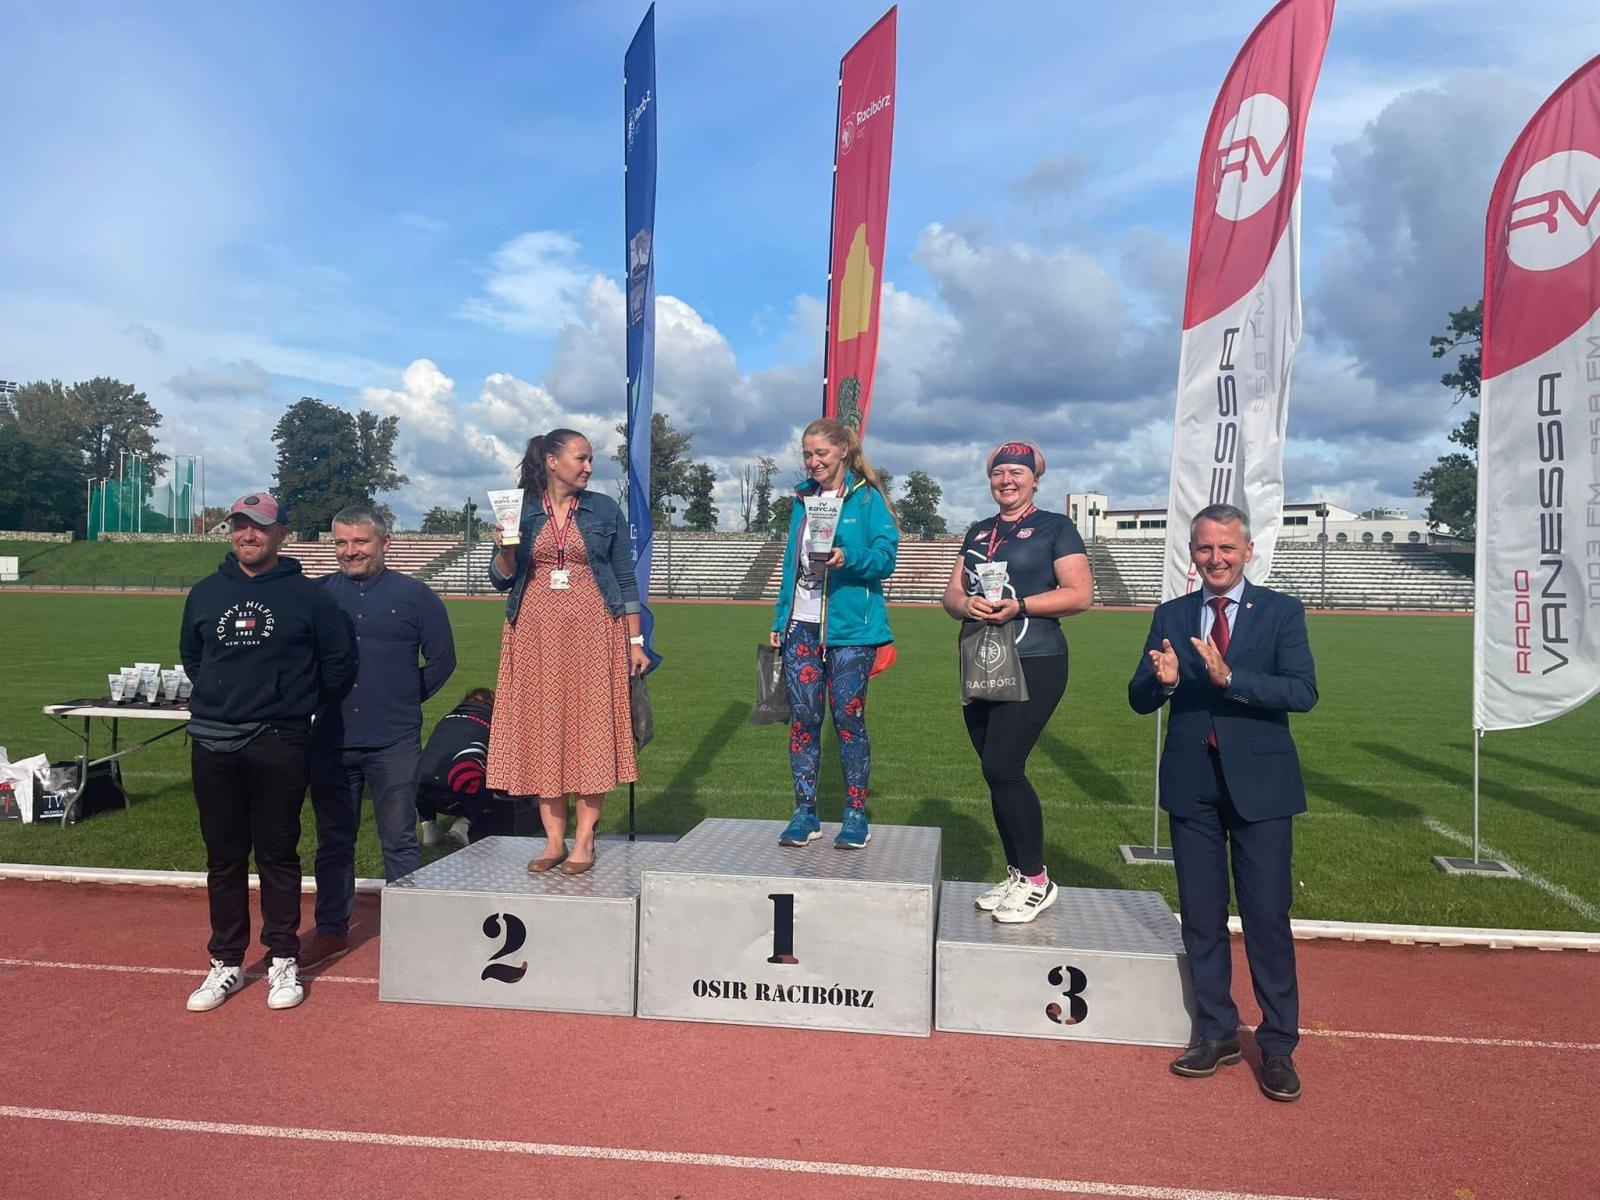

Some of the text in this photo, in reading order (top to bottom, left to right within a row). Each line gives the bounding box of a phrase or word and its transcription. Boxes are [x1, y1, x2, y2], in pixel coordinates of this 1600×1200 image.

[856, 95, 891, 125] Racibórz
[1586, 336, 1600, 381] FM
[1538, 372, 1569, 675] VANESSA
[1586, 483, 1600, 527] FM
[216, 600, 275, 640] TOMMY HILFIGER
[1514, 570, 1531, 674] RADIO
[966, 676, 1017, 689] RACIBÓRZ
[481, 912, 528, 984] 2
[767, 893, 799, 964] 1
[692, 979, 875, 1008] OSIR RACIBÓRZ
[1046, 965, 1089, 1026] 3
